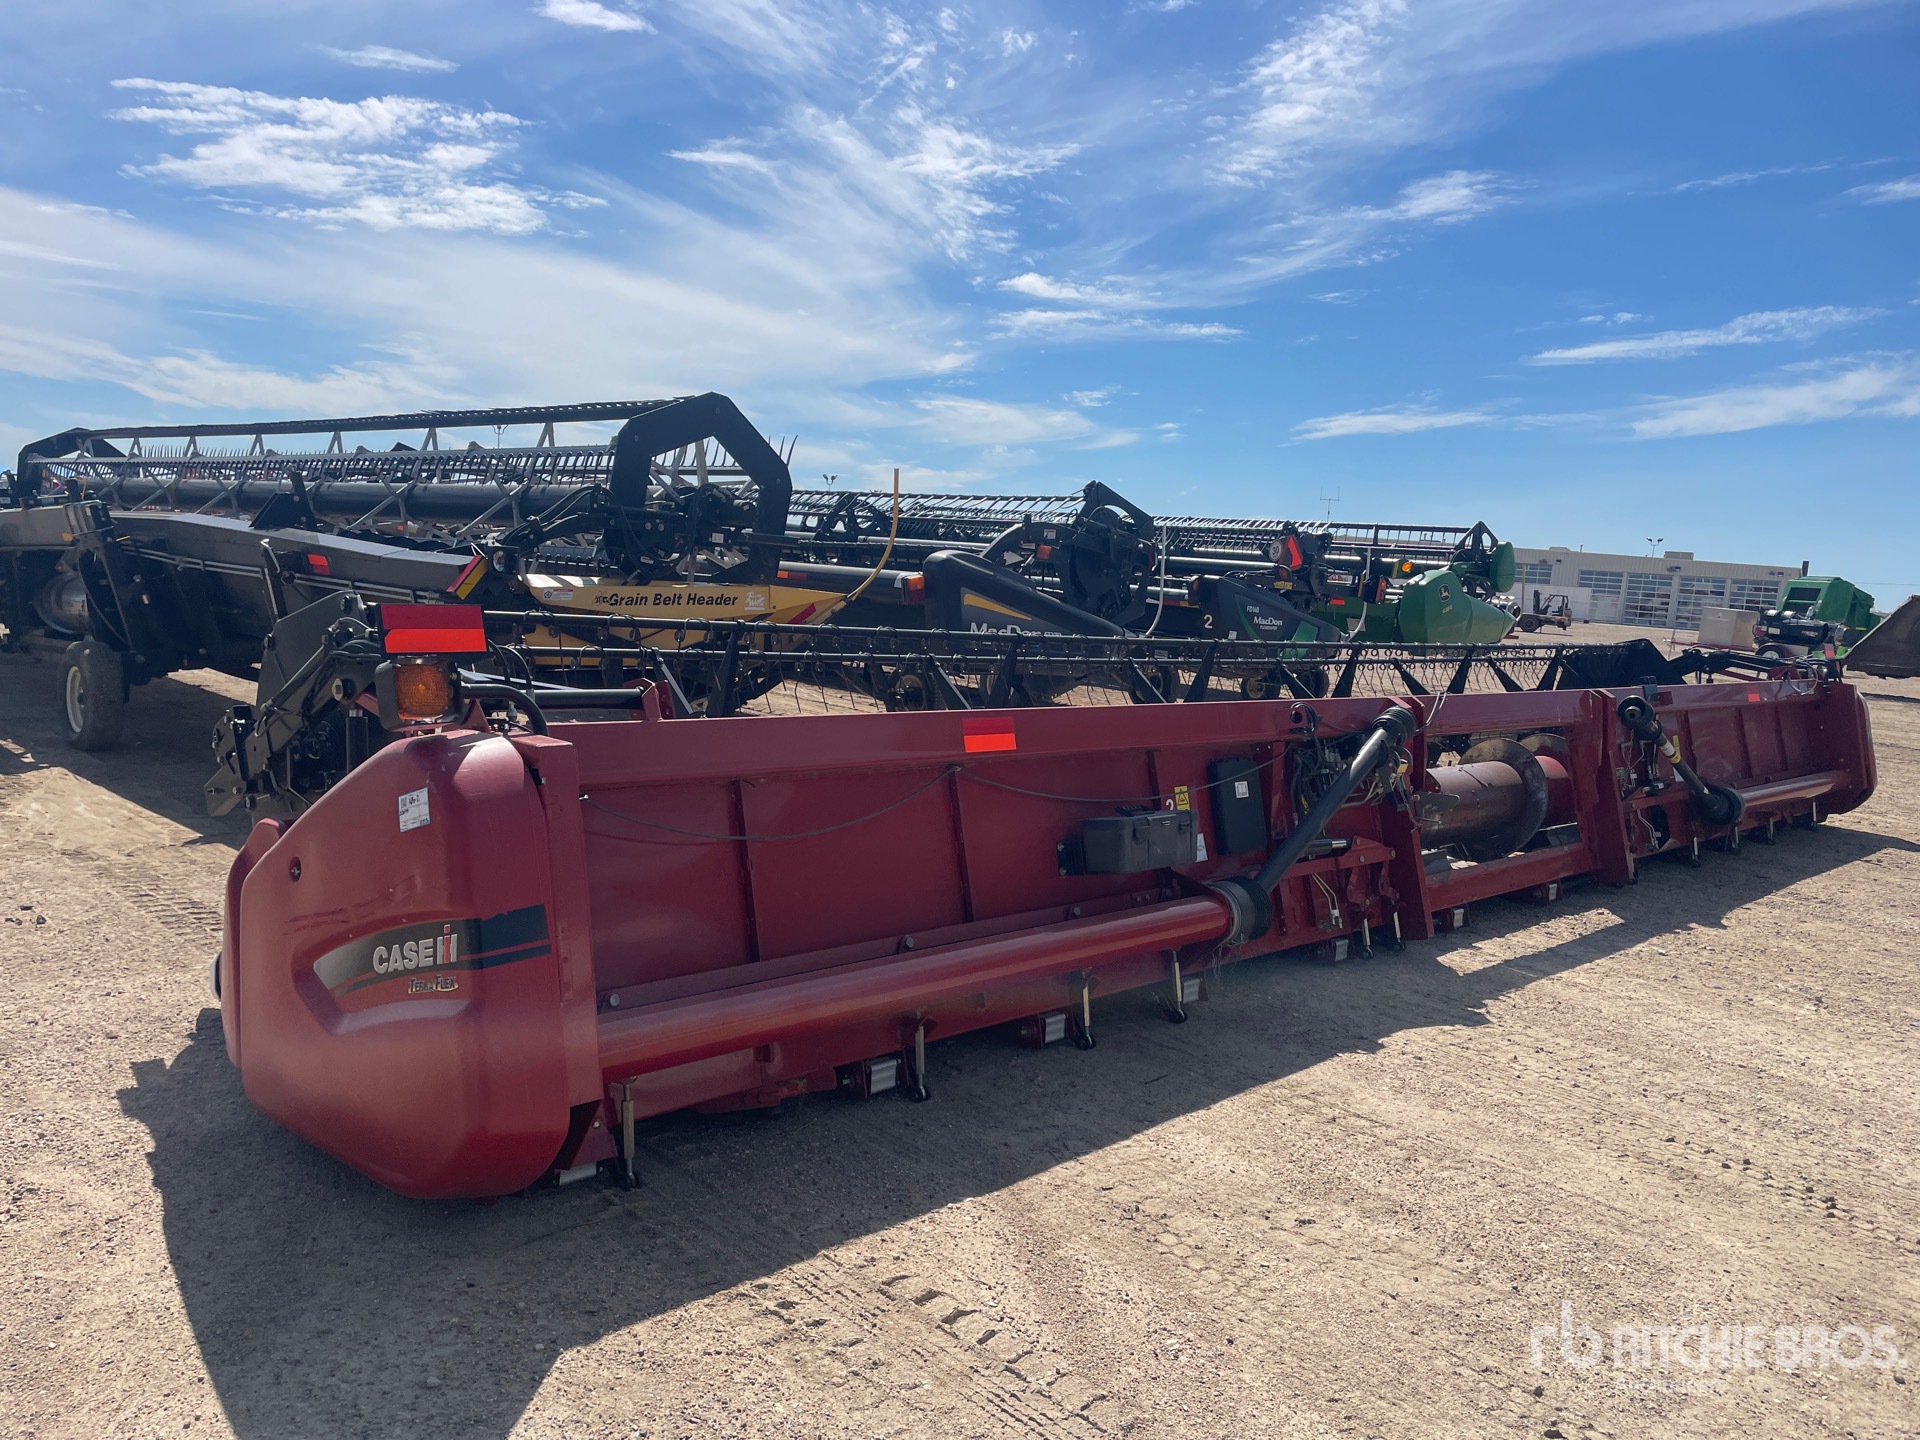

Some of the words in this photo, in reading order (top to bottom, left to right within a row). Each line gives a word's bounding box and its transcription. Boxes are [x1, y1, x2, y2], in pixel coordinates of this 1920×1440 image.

[609, 592, 648, 606] Grain
[652, 593, 683, 606] Belt
[686, 593, 738, 606] Header
[1204, 614, 1213, 629] 2
[1253, 616, 1283, 626] MacDon
